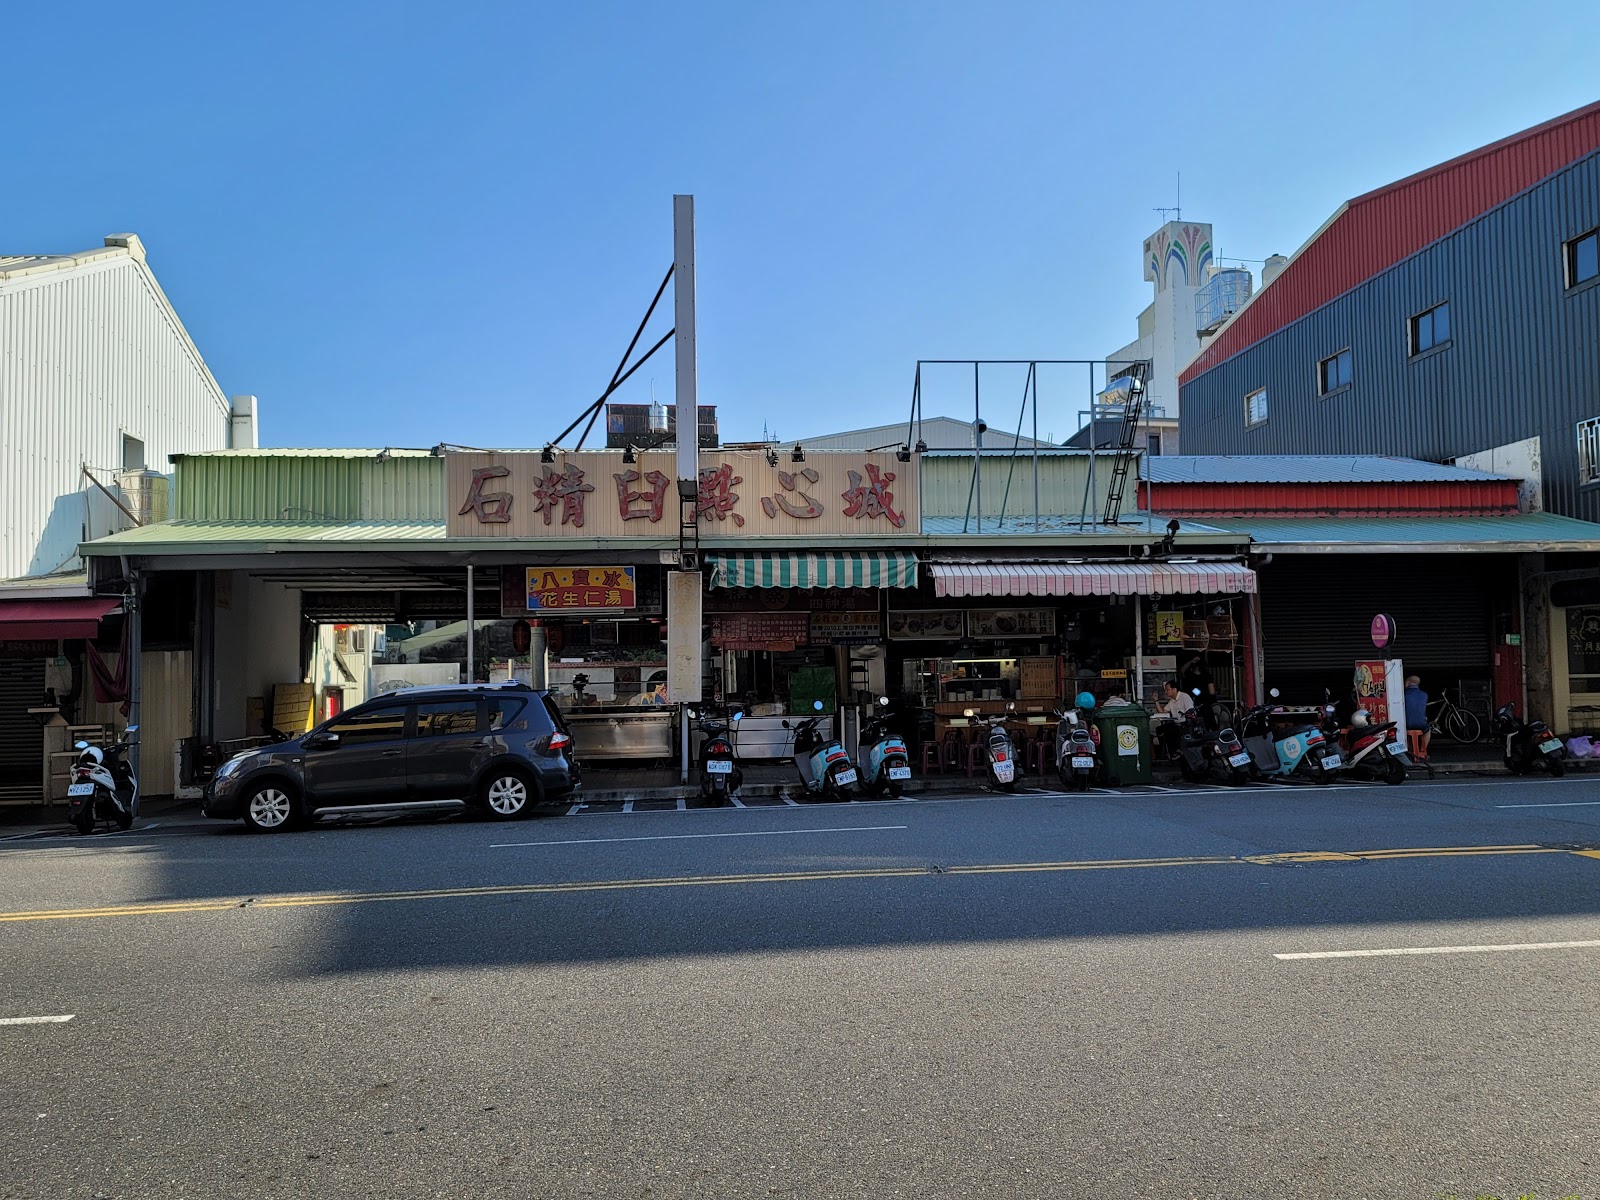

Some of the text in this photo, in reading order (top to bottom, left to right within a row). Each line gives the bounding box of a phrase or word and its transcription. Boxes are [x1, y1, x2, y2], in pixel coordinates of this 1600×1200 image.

[458, 463, 906, 528] 石精臼點心城
[540, 590, 623, 607] 花生仁湯
[809, 597, 856, 609] 四神湯
[1161, 616, 1181, 638] 羊肉
[1286, 741, 1296, 751] Go
